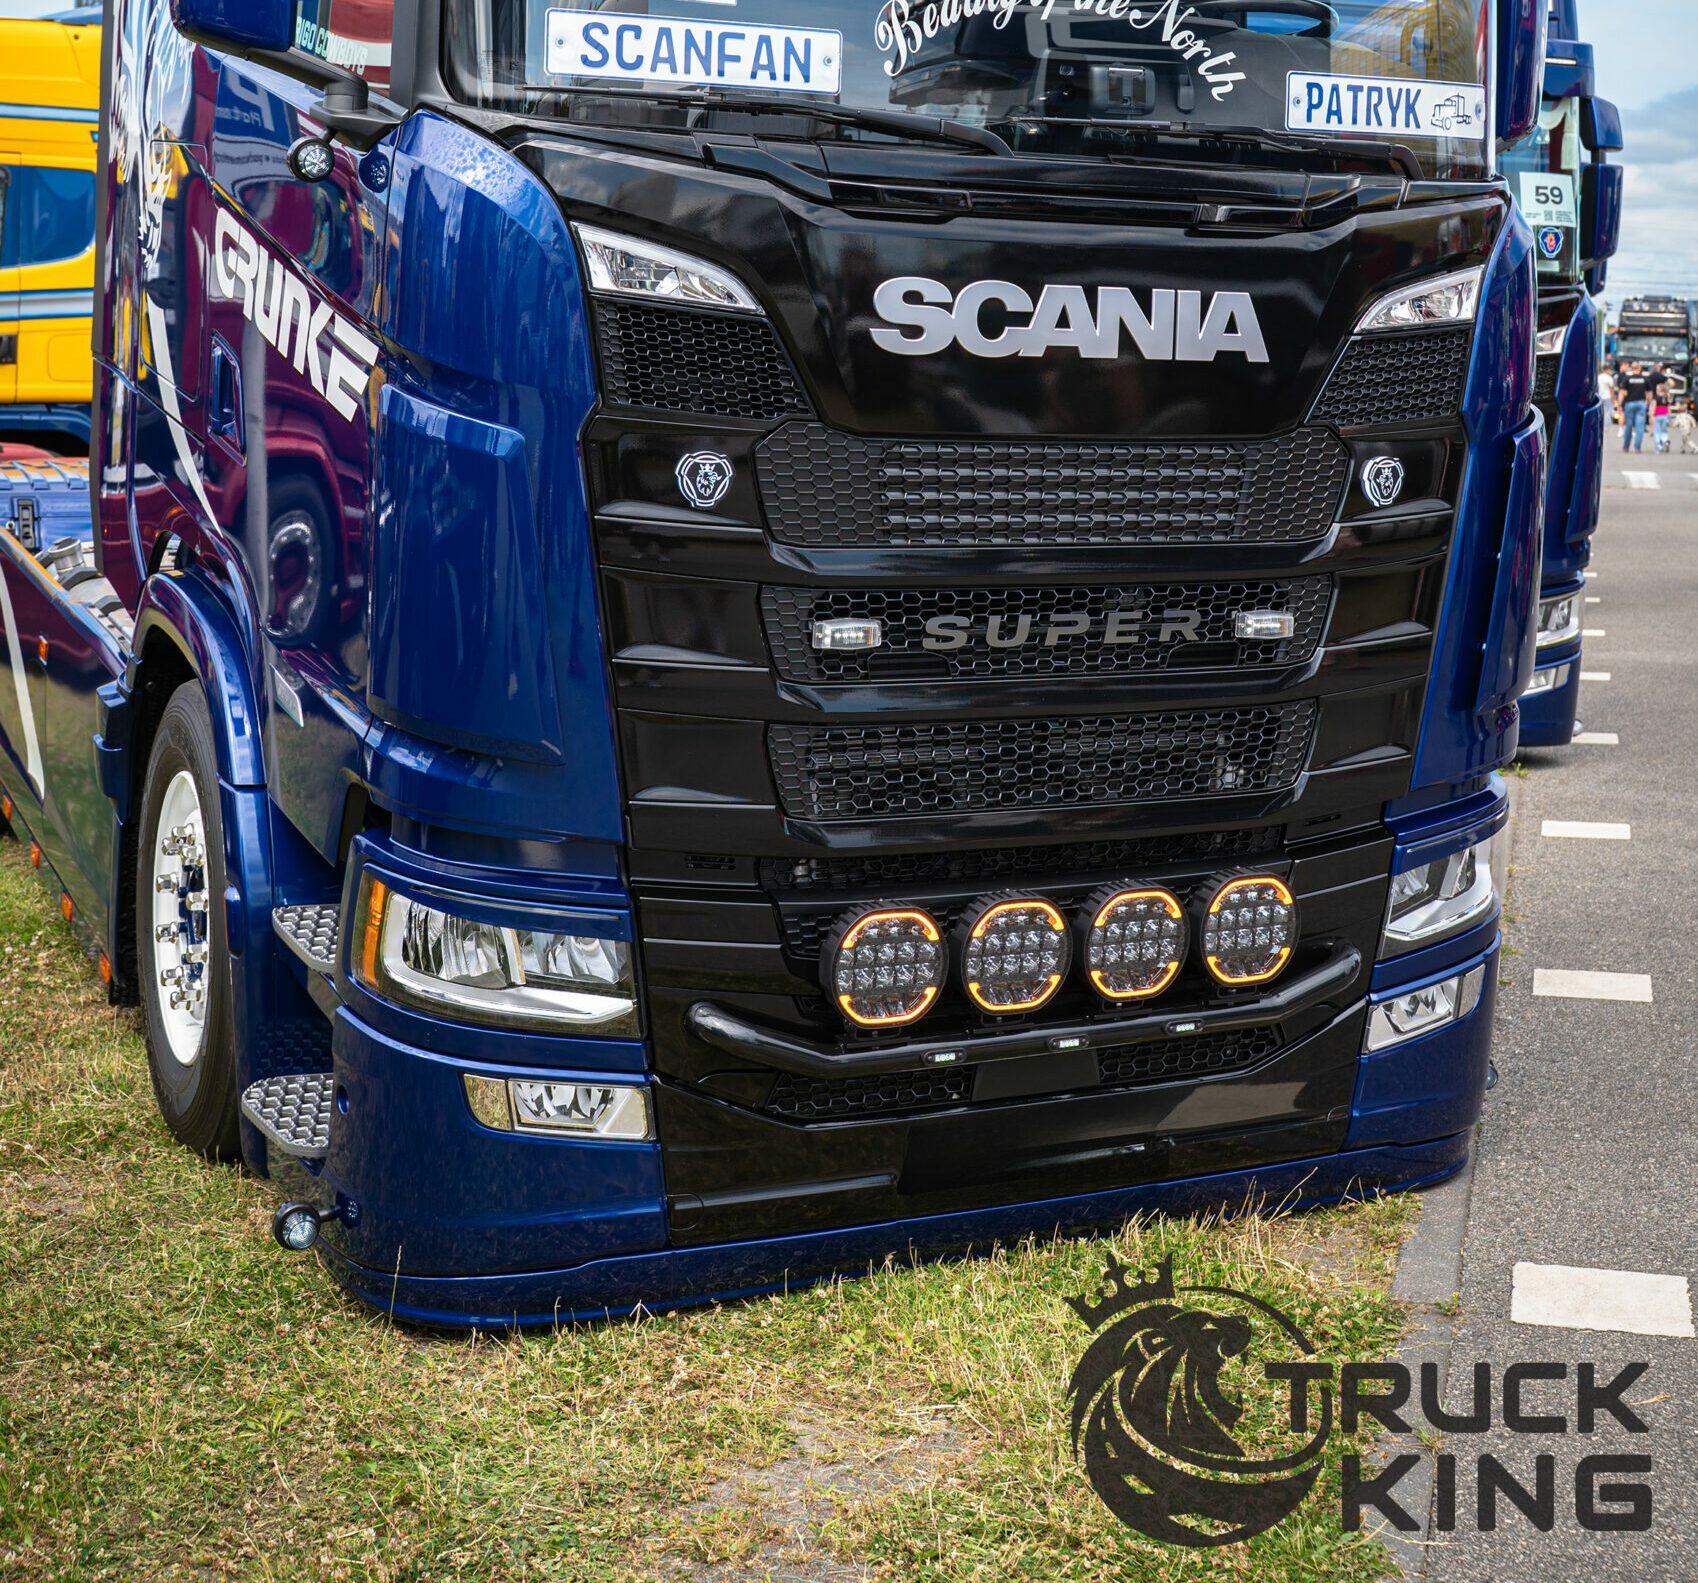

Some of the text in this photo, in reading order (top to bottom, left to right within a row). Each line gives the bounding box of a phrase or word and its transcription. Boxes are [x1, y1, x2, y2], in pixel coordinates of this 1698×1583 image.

[580, 21, 812, 83] SCANFAN
[1129, 0, 1246, 102] North
[1305, 82, 1422, 129] PATRYK
[1535, 185, 1563, 205] 59
[869, 276, 1270, 363] SCANIA
[922, 609, 1202, 650] SUPER
